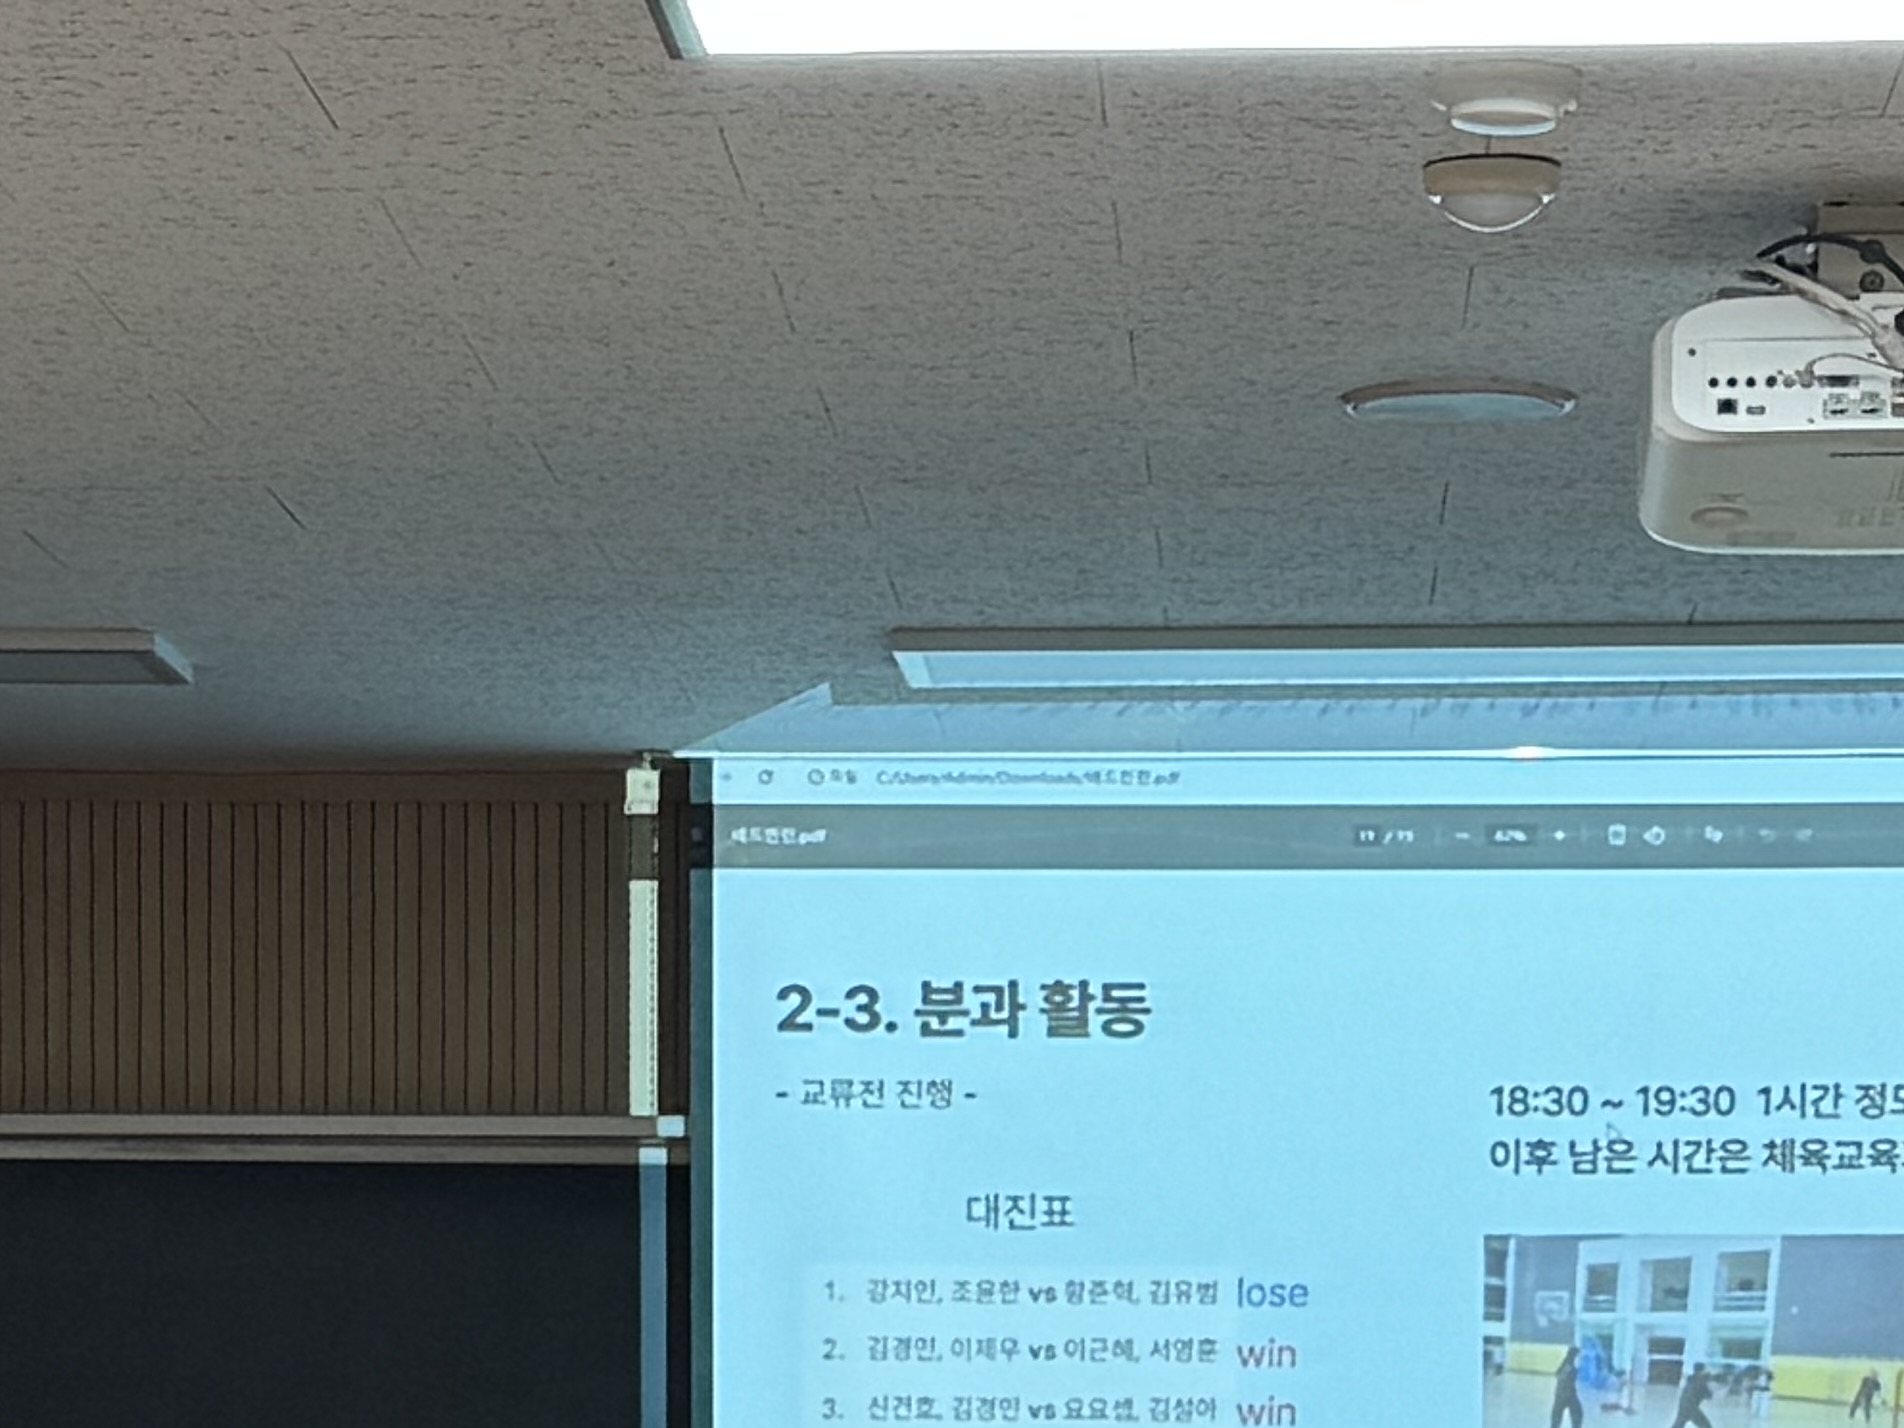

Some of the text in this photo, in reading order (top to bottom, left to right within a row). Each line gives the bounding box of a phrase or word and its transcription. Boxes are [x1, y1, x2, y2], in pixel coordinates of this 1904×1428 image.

[776, 979, 1152, 1039] 2-3. 분과 활동
[801, 1079, 884, 1109] 교류전
[897, 1079, 952, 1110] 진행
[1490, 1085, 1589, 1117] 18:30
[1636, 1085, 1736, 1117] 19:30
[1757, 1082, 1846, 1119] 1시간
[1490, 1138, 1559, 1176] 이후
[1569, 1138, 1638, 1175] 남은
[1647, 1138, 1752, 1175] 시간은
[966, 1192, 1075, 1231] 대진표
[824, 1280, 844, 1302] 1.
[1028, 1286, 1057, 1303] vs
[1238, 1277, 1309, 1307] lose
[822, 1337, 845, 1361] 2.
[1029, 1344, 1057, 1361] vs
[1237, 1337, 1296, 1368] win
[822, 1397, 844, 1420] 3.
[1028, 1403, 1056, 1420] vs
[1236, 1395, 1296, 1427] win
